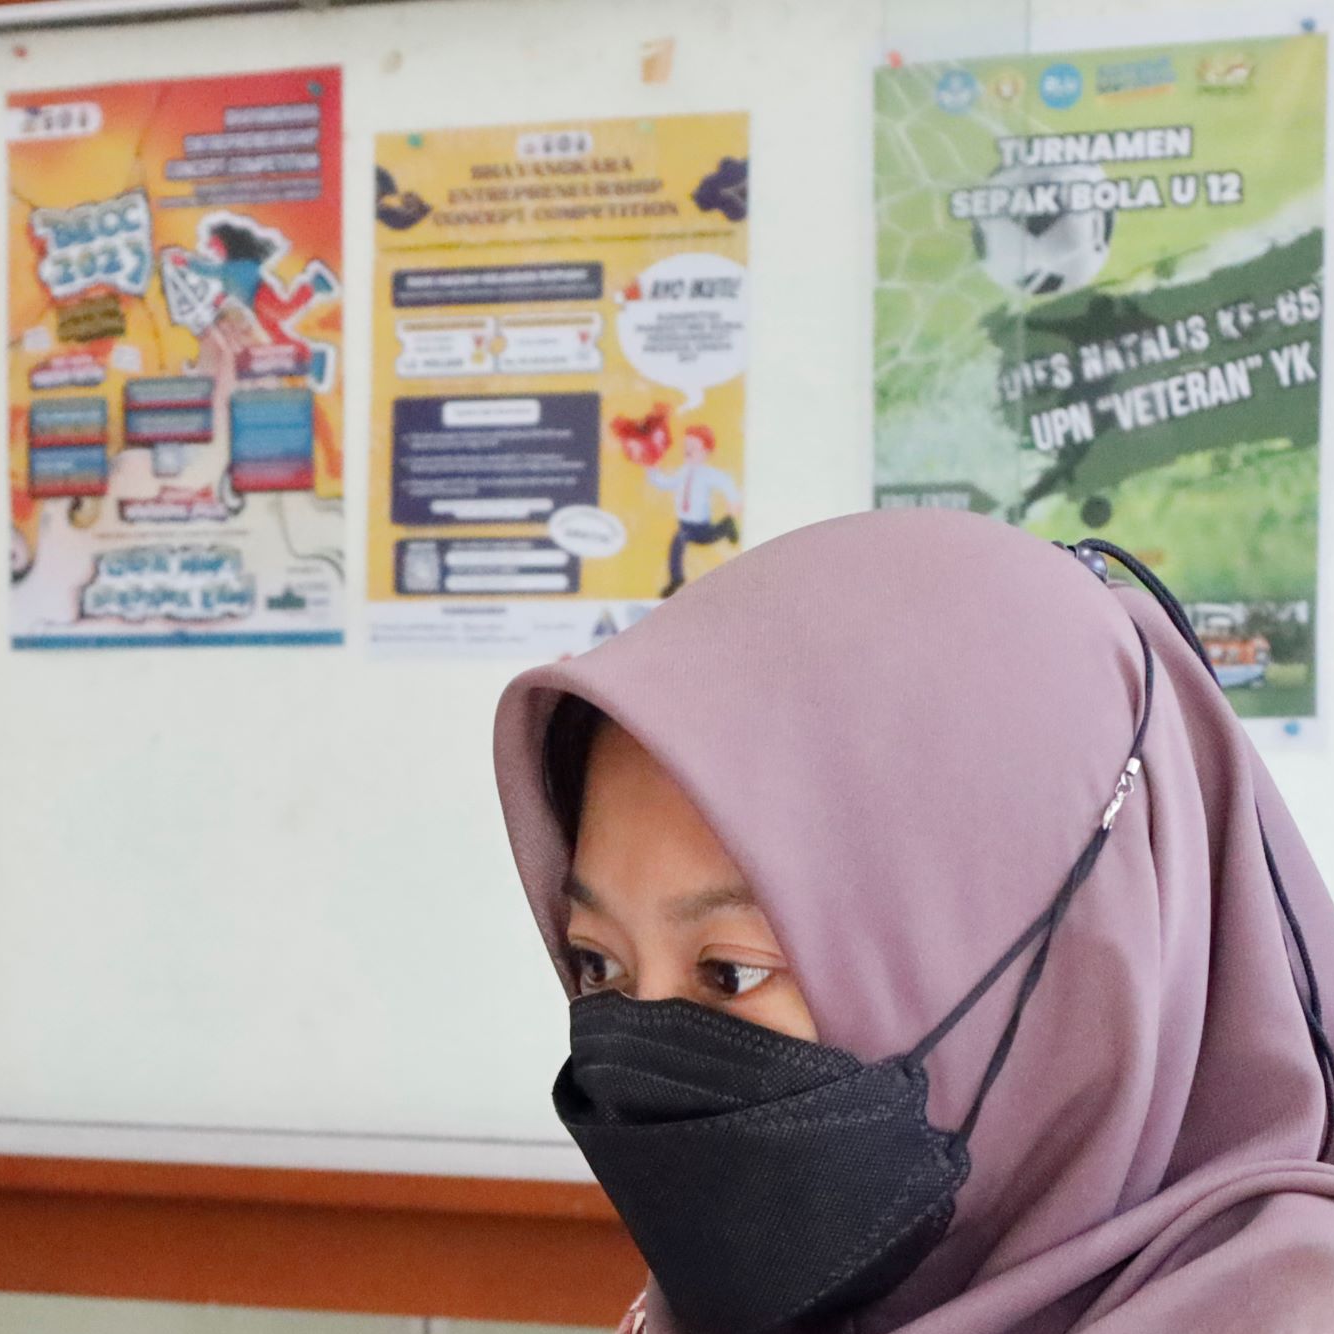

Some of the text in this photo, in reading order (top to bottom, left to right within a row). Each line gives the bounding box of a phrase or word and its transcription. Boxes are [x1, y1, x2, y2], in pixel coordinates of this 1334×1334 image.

[997, 125, 1193, 167] TURNAMEN
[950, 170, 1243, 218] SEPAK BOLA U 12
[1079, 315, 1210, 381] NATALIS
[1030, 401, 1095, 452] UPN
[1269, 342, 1318, 388] YK
